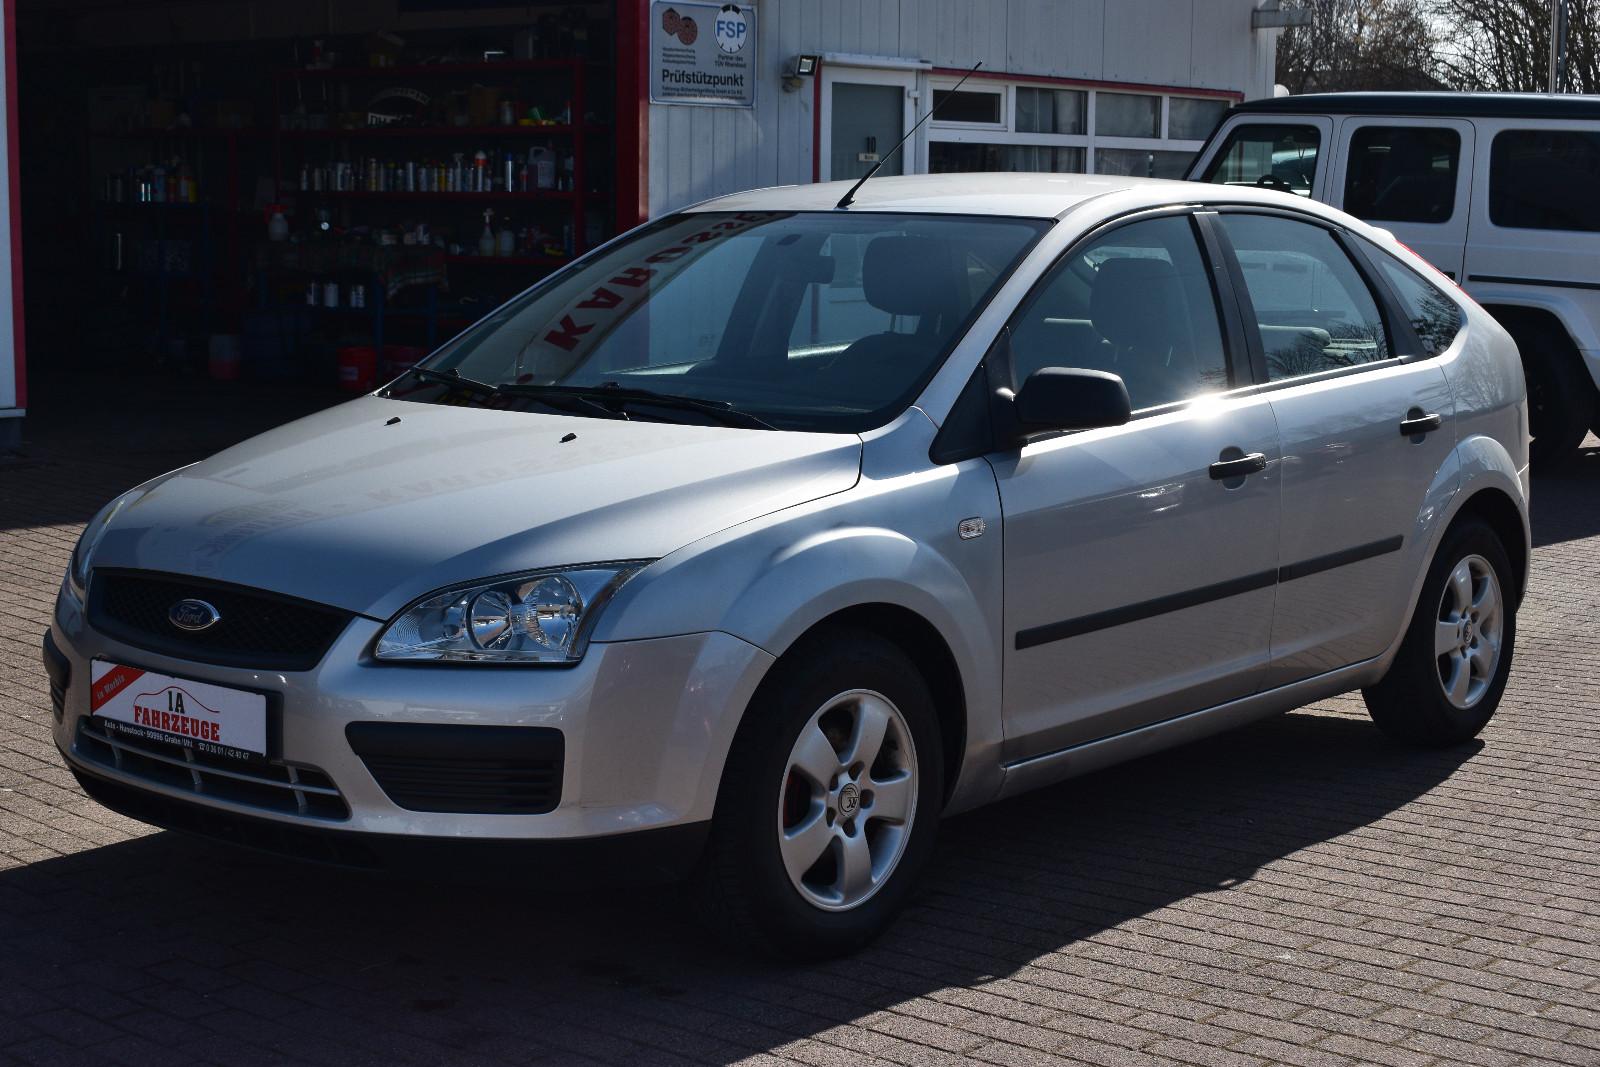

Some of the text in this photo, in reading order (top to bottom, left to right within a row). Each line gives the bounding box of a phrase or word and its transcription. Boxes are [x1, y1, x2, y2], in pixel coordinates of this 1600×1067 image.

[717, 20, 746, 39] FSP
[662, 69, 744, 86] Prüfstützpunkt
[176, 606, 204, 624] Ford
[133, 705, 220, 741] FAHRZEUGE
